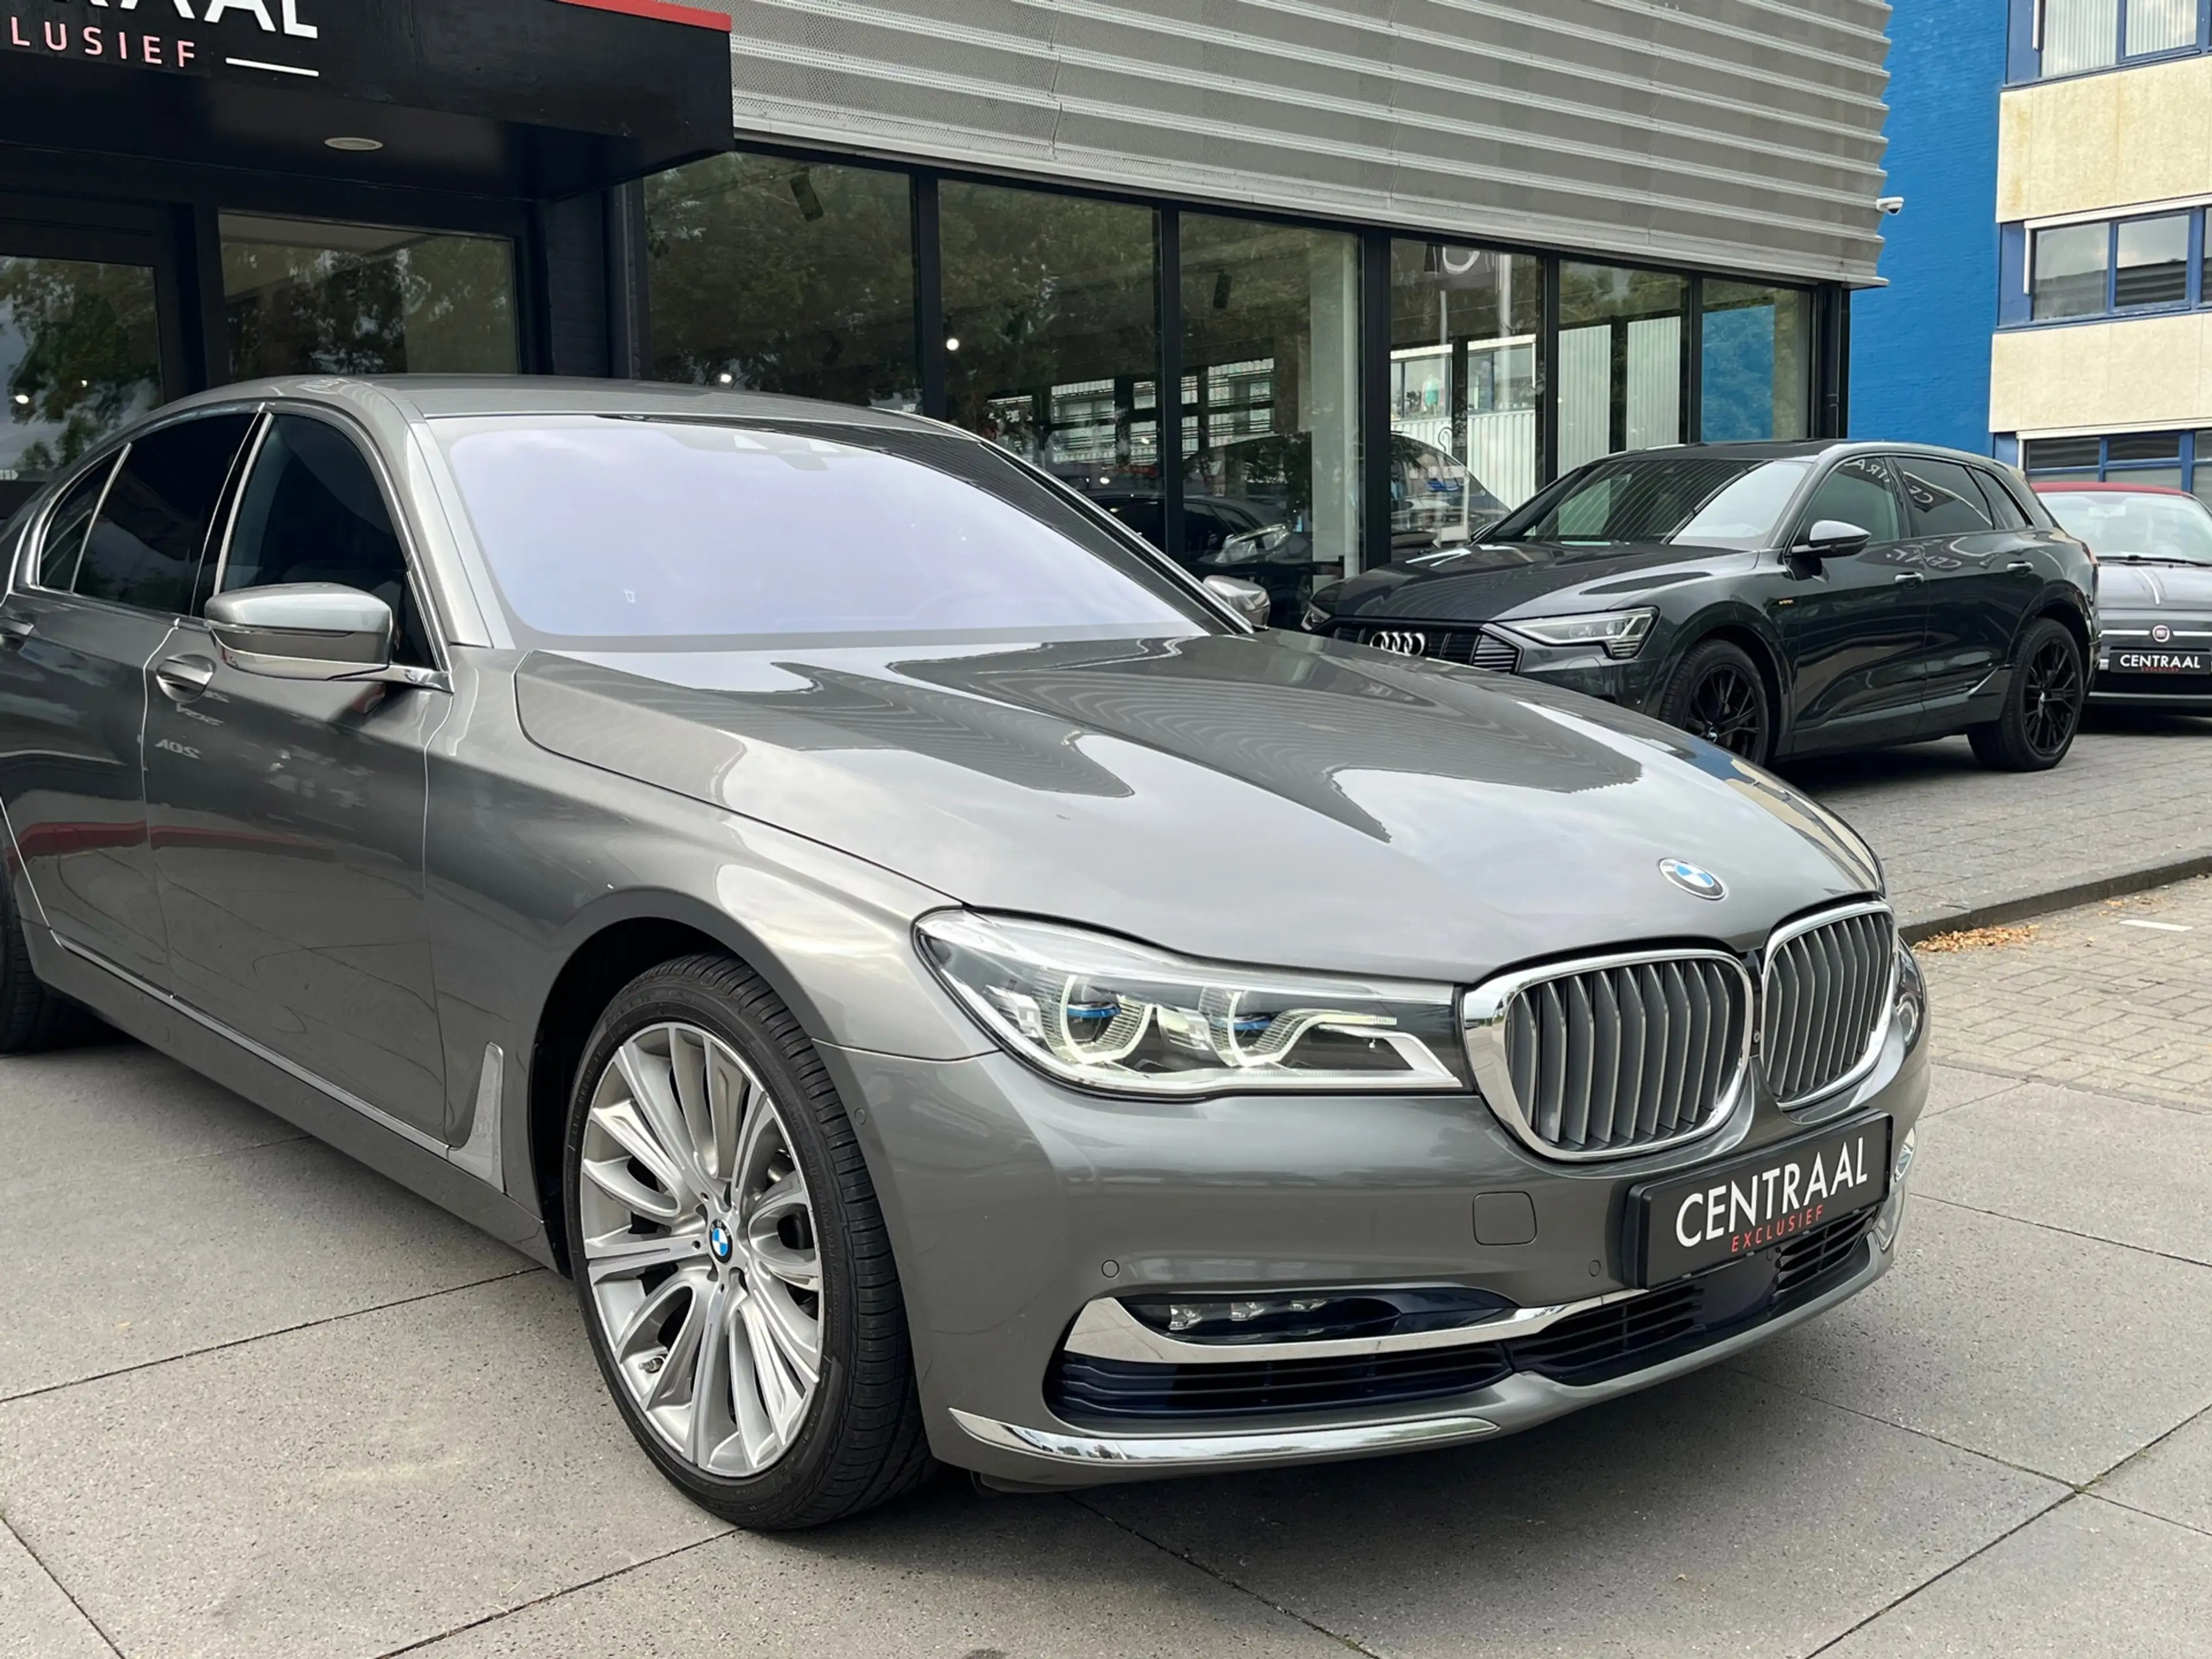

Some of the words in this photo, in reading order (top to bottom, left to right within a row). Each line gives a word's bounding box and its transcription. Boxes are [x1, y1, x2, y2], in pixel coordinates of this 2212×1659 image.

[10, 16, 196, 68] LUSIEF
[2120, 654, 2200, 668] CENTRAAL
[1676, 1137, 1868, 1248] CENTRAAL
[1732, 1205, 1824, 1253] EXCLUSIEF
